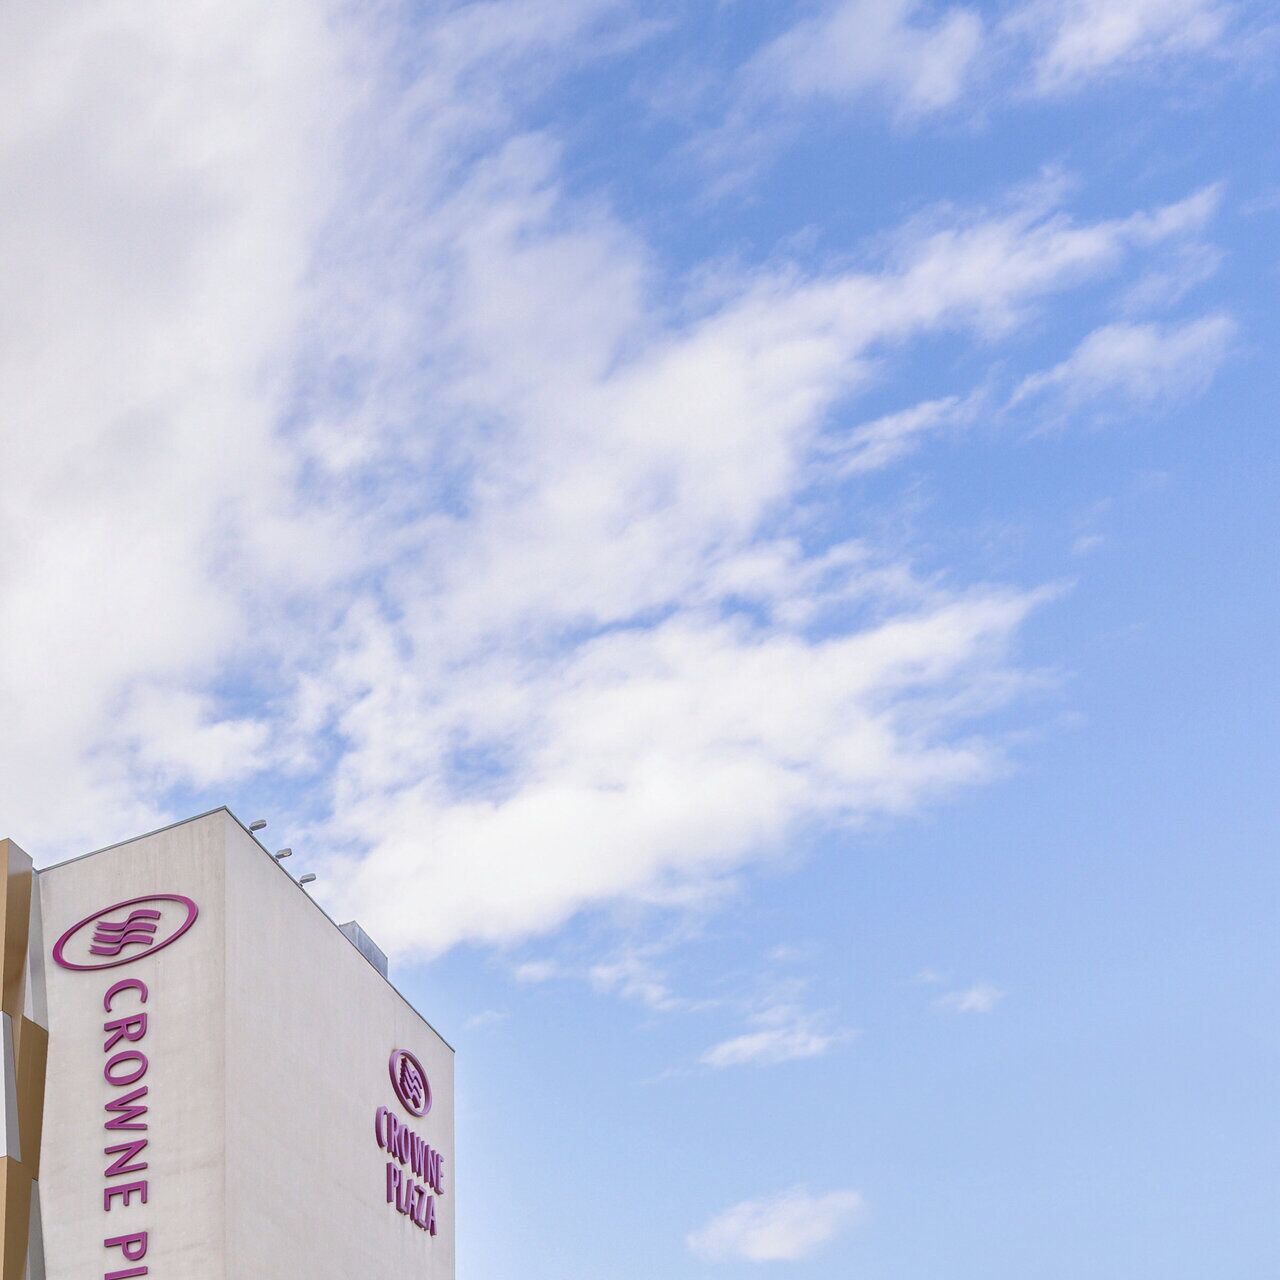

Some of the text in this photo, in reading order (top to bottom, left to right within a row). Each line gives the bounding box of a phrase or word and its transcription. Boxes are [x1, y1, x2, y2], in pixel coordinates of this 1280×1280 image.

[104, 979, 148, 1211] CROWNE
[375, 1105, 444, 1195] CROWNE
[386, 1162, 438, 1236] PLAZA
